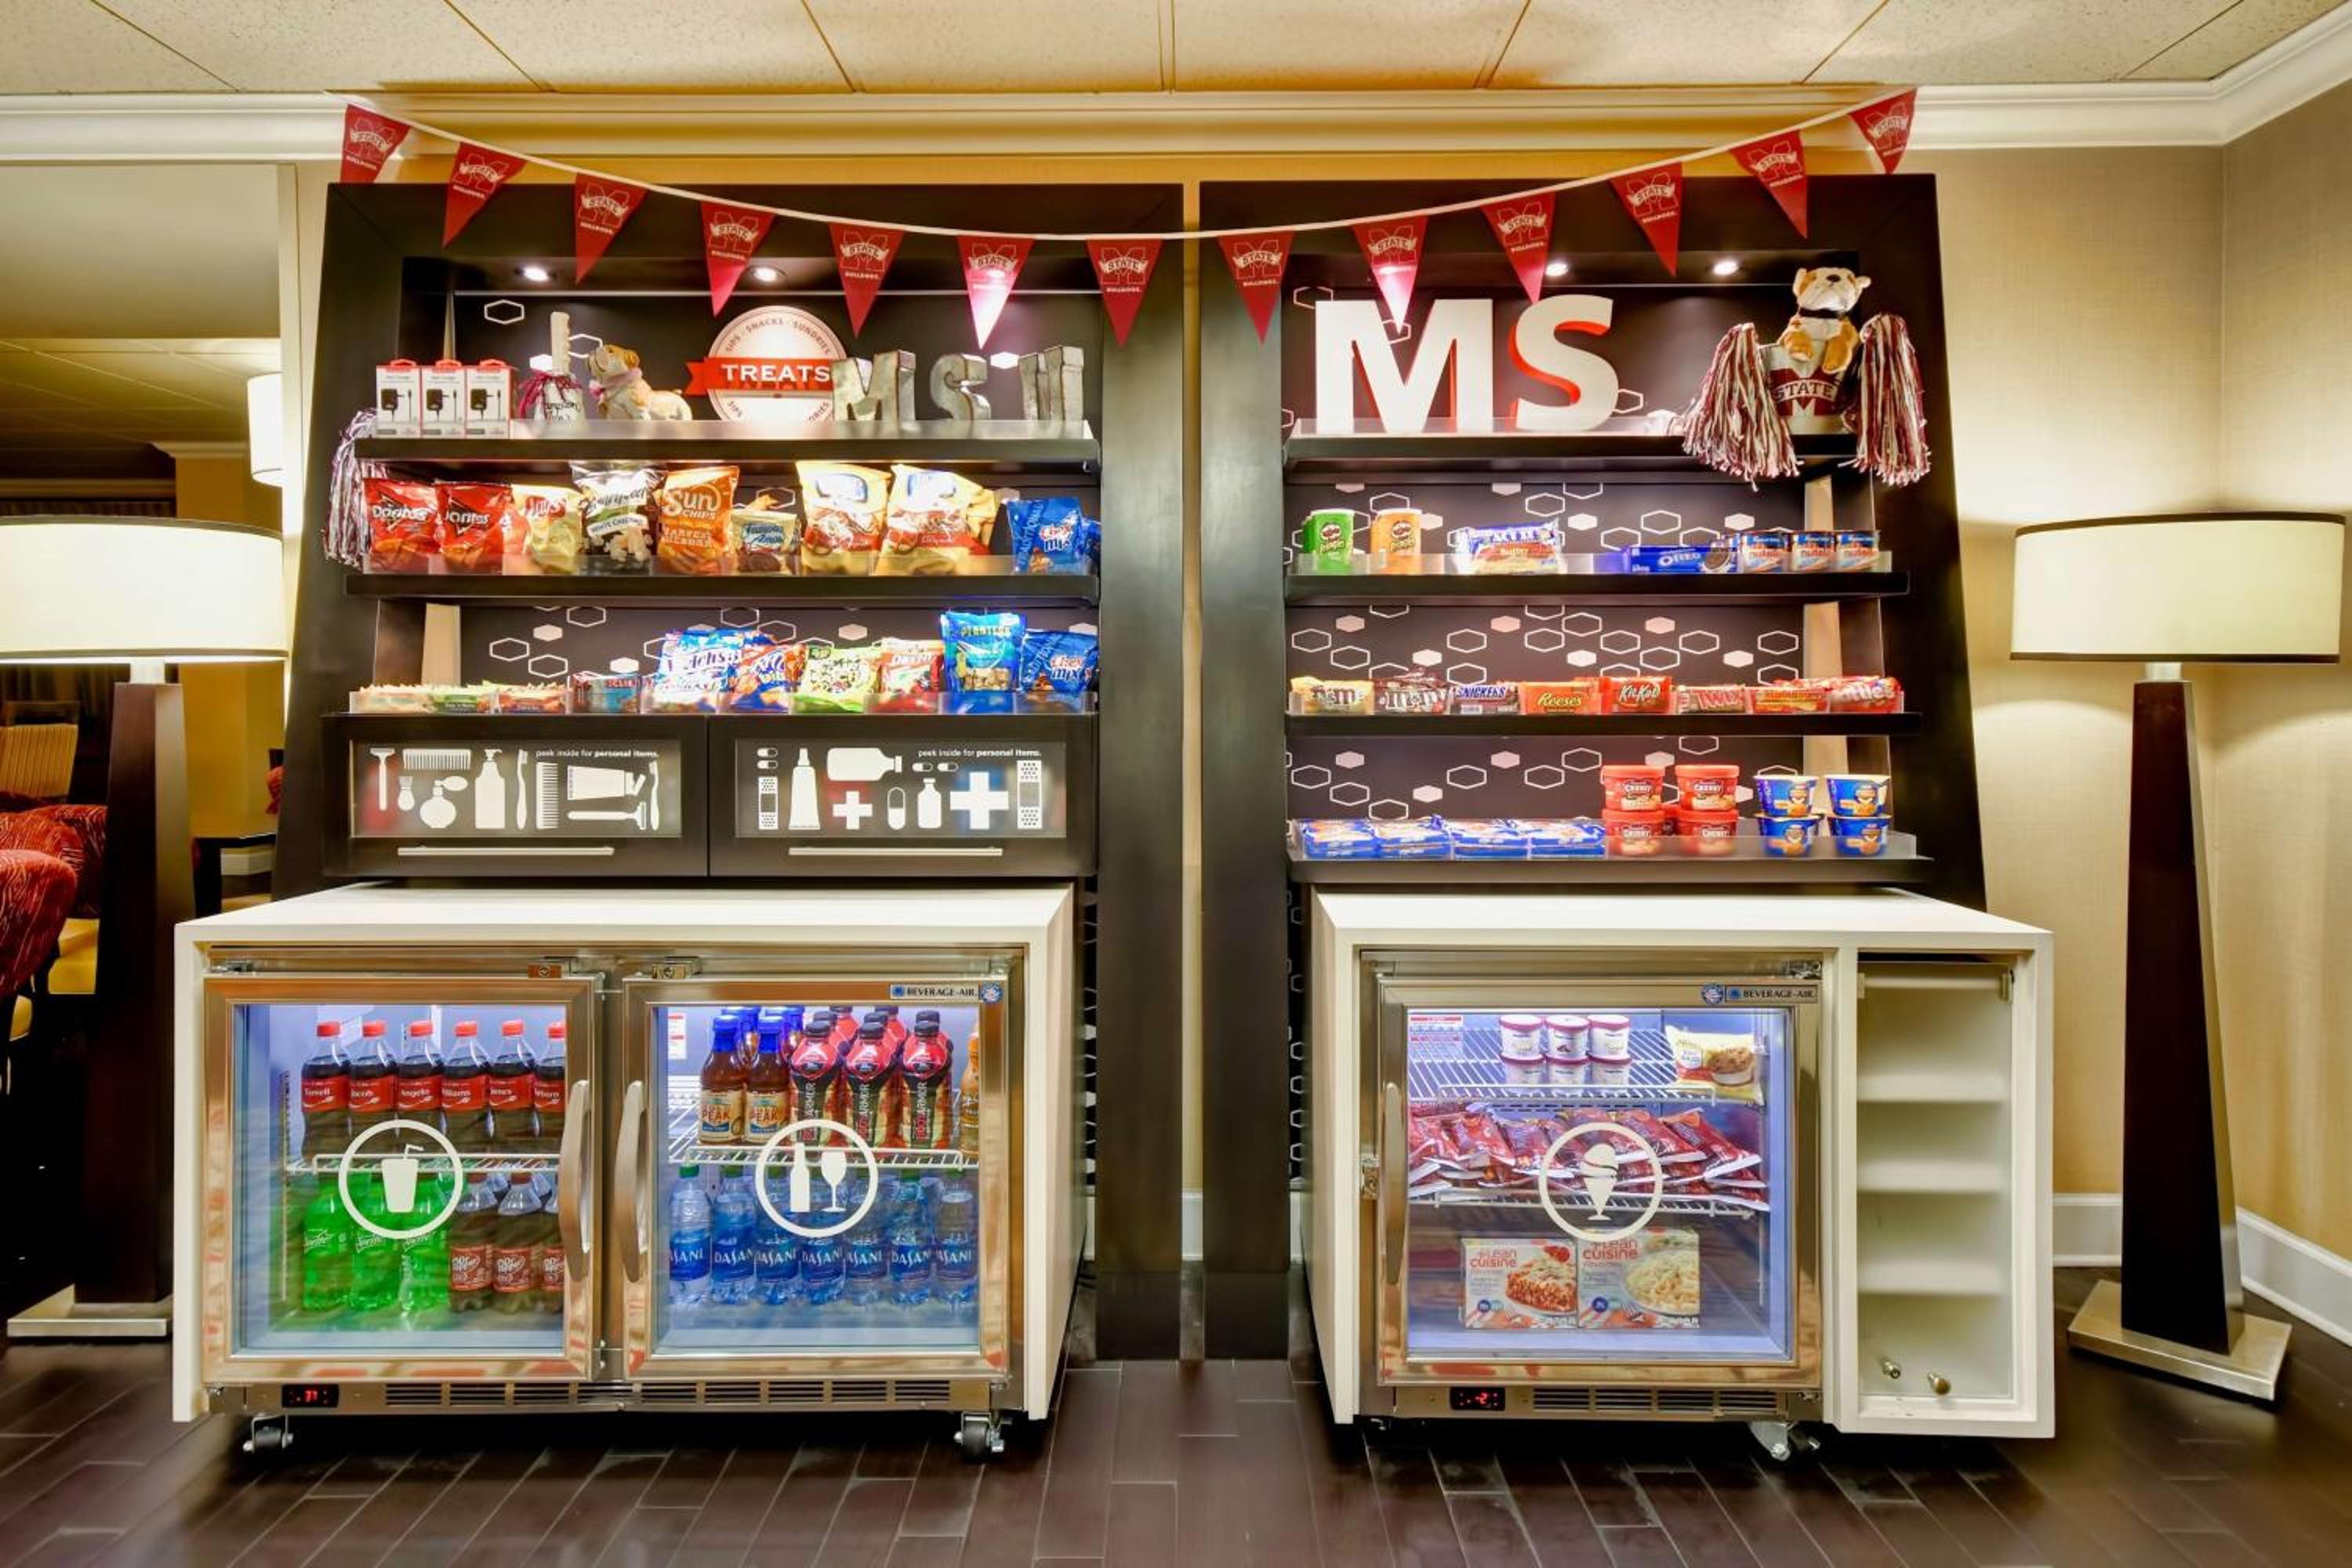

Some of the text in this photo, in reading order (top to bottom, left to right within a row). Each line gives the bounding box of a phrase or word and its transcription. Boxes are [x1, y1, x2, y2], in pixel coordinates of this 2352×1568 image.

[358, 132, 384, 148] STATE
[1761, 156, 1790, 169] STATE
[469, 165, 497, 182] STATE
[1638, 187, 1668, 201] STATE
[588, 196, 619, 215] STATE
[1508, 216, 1537, 230] STATE
[719, 223, 748, 239] STATE
[849, 243, 880, 258] STATE
[1377, 238, 1408, 252] STATE
[977, 255, 1009, 269] STATE
[1107, 257, 1139, 271] STATE
[1242, 251, 1273, 266] STATE
[745, 317, 785, 336] SNACKS
[793, 320, 832, 356] SUNDRIES
[720, 363, 831, 383] TREATS
[1775, 382, 1834, 400] STATE
[662, 486, 717, 517] Sun
[372, 505, 428, 521] Doritos
[682, 510, 716, 519] CHIPS
[1657, 552, 1701, 567] OREO
[1456, 686, 1506, 699] SNICKERS
[535, 750, 554, 758] peek
[557, 749, 579, 757] inside
[581, 749, 593, 757] for
[593, 749, 631, 758] personal
[976, 749, 1014, 757] personal
[1582, 1248, 1639, 1260] cuisine
[1470, 1258, 1517, 1268] cuisine
